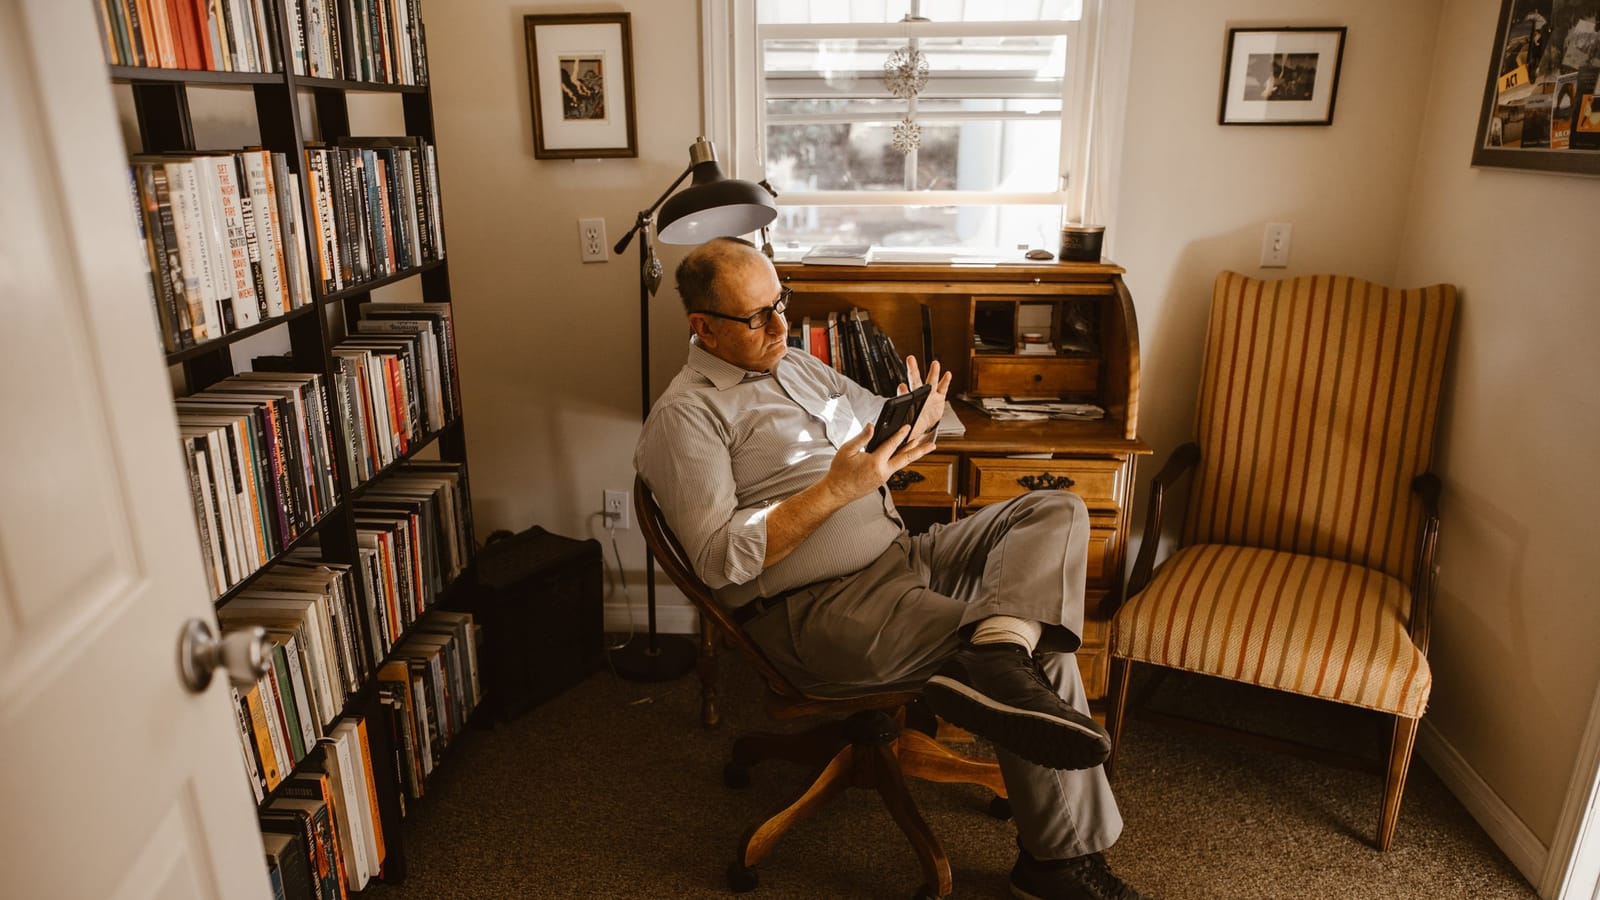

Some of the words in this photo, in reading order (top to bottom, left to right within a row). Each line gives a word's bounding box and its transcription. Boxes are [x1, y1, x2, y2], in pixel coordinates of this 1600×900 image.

[1505, 73, 1518, 89] ACT
[217, 164, 227, 175] SET
[219, 175, 230, 185] THE
[221, 185, 235, 196] NIGHT
[224, 207, 236, 217] FIRE
[188, 169, 201, 218] LINEAGES
[198, 231, 211, 288] MODERNITY
[240, 197, 260, 263] EXTINCTION
[263, 206, 273, 250] CHARLES
[271, 266, 279, 292] MANN
[235, 269, 245, 278] AND
[278, 438, 283, 447] OF
